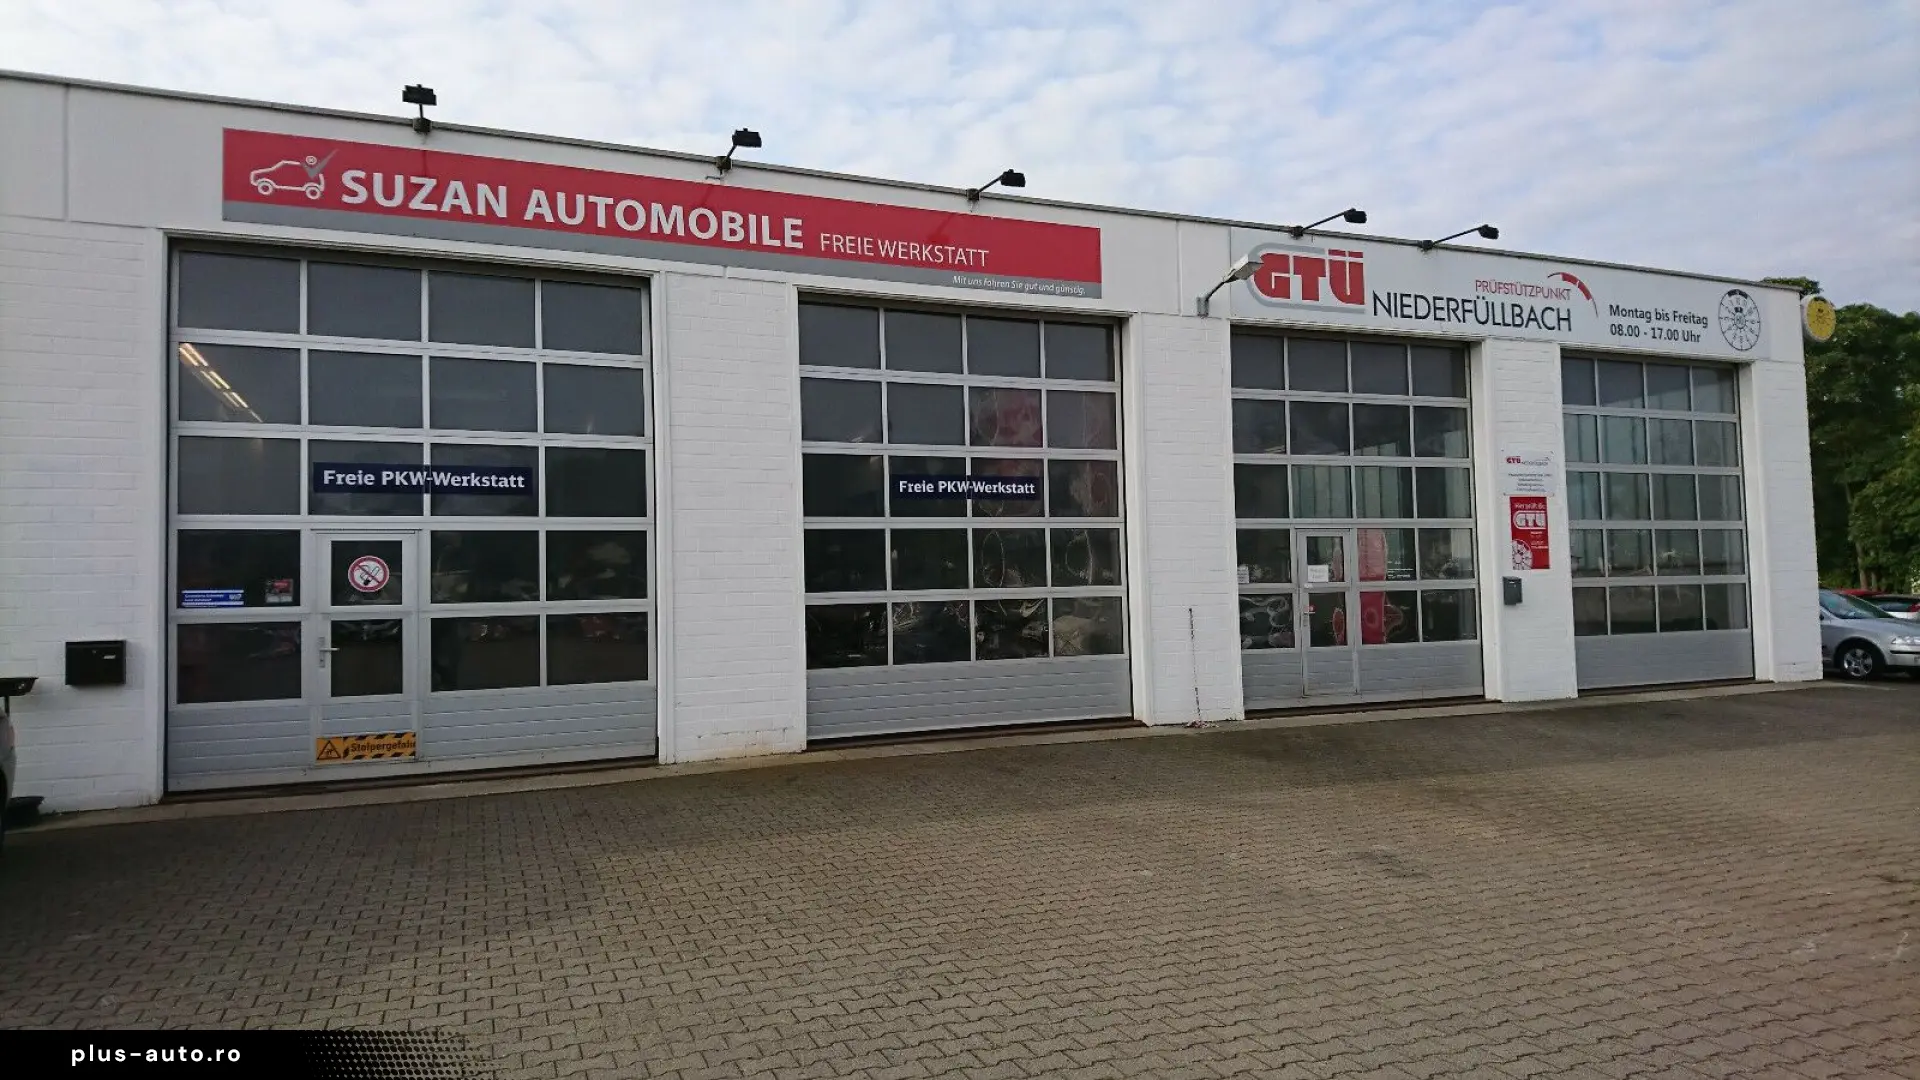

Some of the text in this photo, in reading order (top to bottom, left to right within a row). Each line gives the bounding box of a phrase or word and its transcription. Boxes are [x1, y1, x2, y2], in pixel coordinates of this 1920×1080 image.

[340, 169, 804, 249] SUZAN AUTOMOBILE
[820, 233, 989, 267] FREIE WERKSTATT
[953, 275, 967, 285] Mit
[968, 278, 982, 286] uns
[983, 278, 1010, 290] fahren
[1011, 280, 1022, 289] Sie
[1024, 282, 1038, 293] gut
[1039, 284, 1055, 292] und
[1254, 249, 1365, 305] GTÜ
[1475, 278, 1571, 300] PRÜFSTÜTZPUNKT
[1372, 289, 1572, 332] NIEDERFÜLLBACH
[1609, 304, 1708, 328] Montag bis Freitag
[1610, 323, 1640, 338] 08.00
[1651, 327, 1679, 341] 17.00
[1682, 330, 1701, 342] Uhr
[323, 469, 525, 488] Freie PKW-Werkstatt
[899, 480, 1035, 494] Freie PKW-Werkstatt
